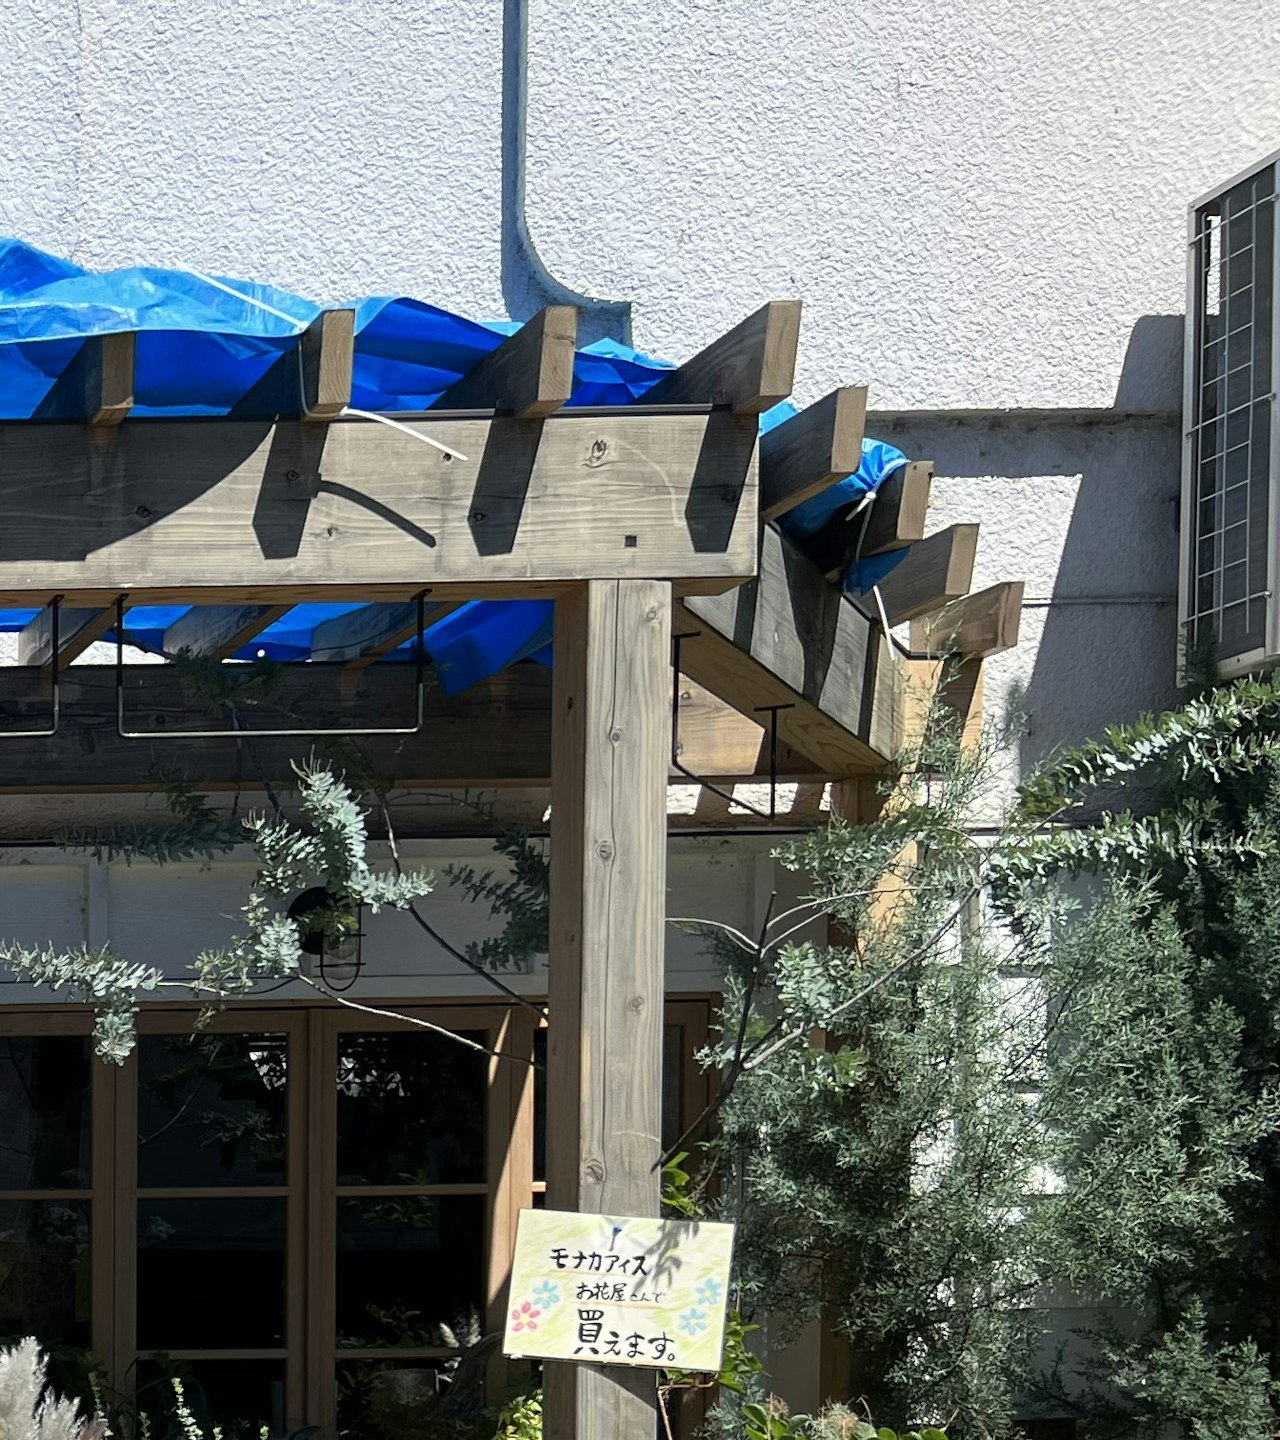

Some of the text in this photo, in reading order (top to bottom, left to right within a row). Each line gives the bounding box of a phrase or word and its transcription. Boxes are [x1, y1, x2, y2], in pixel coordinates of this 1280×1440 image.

[576, 1282, 667, 1304] お花屋さんで
[573, 1308, 676, 1363] 買えます。
